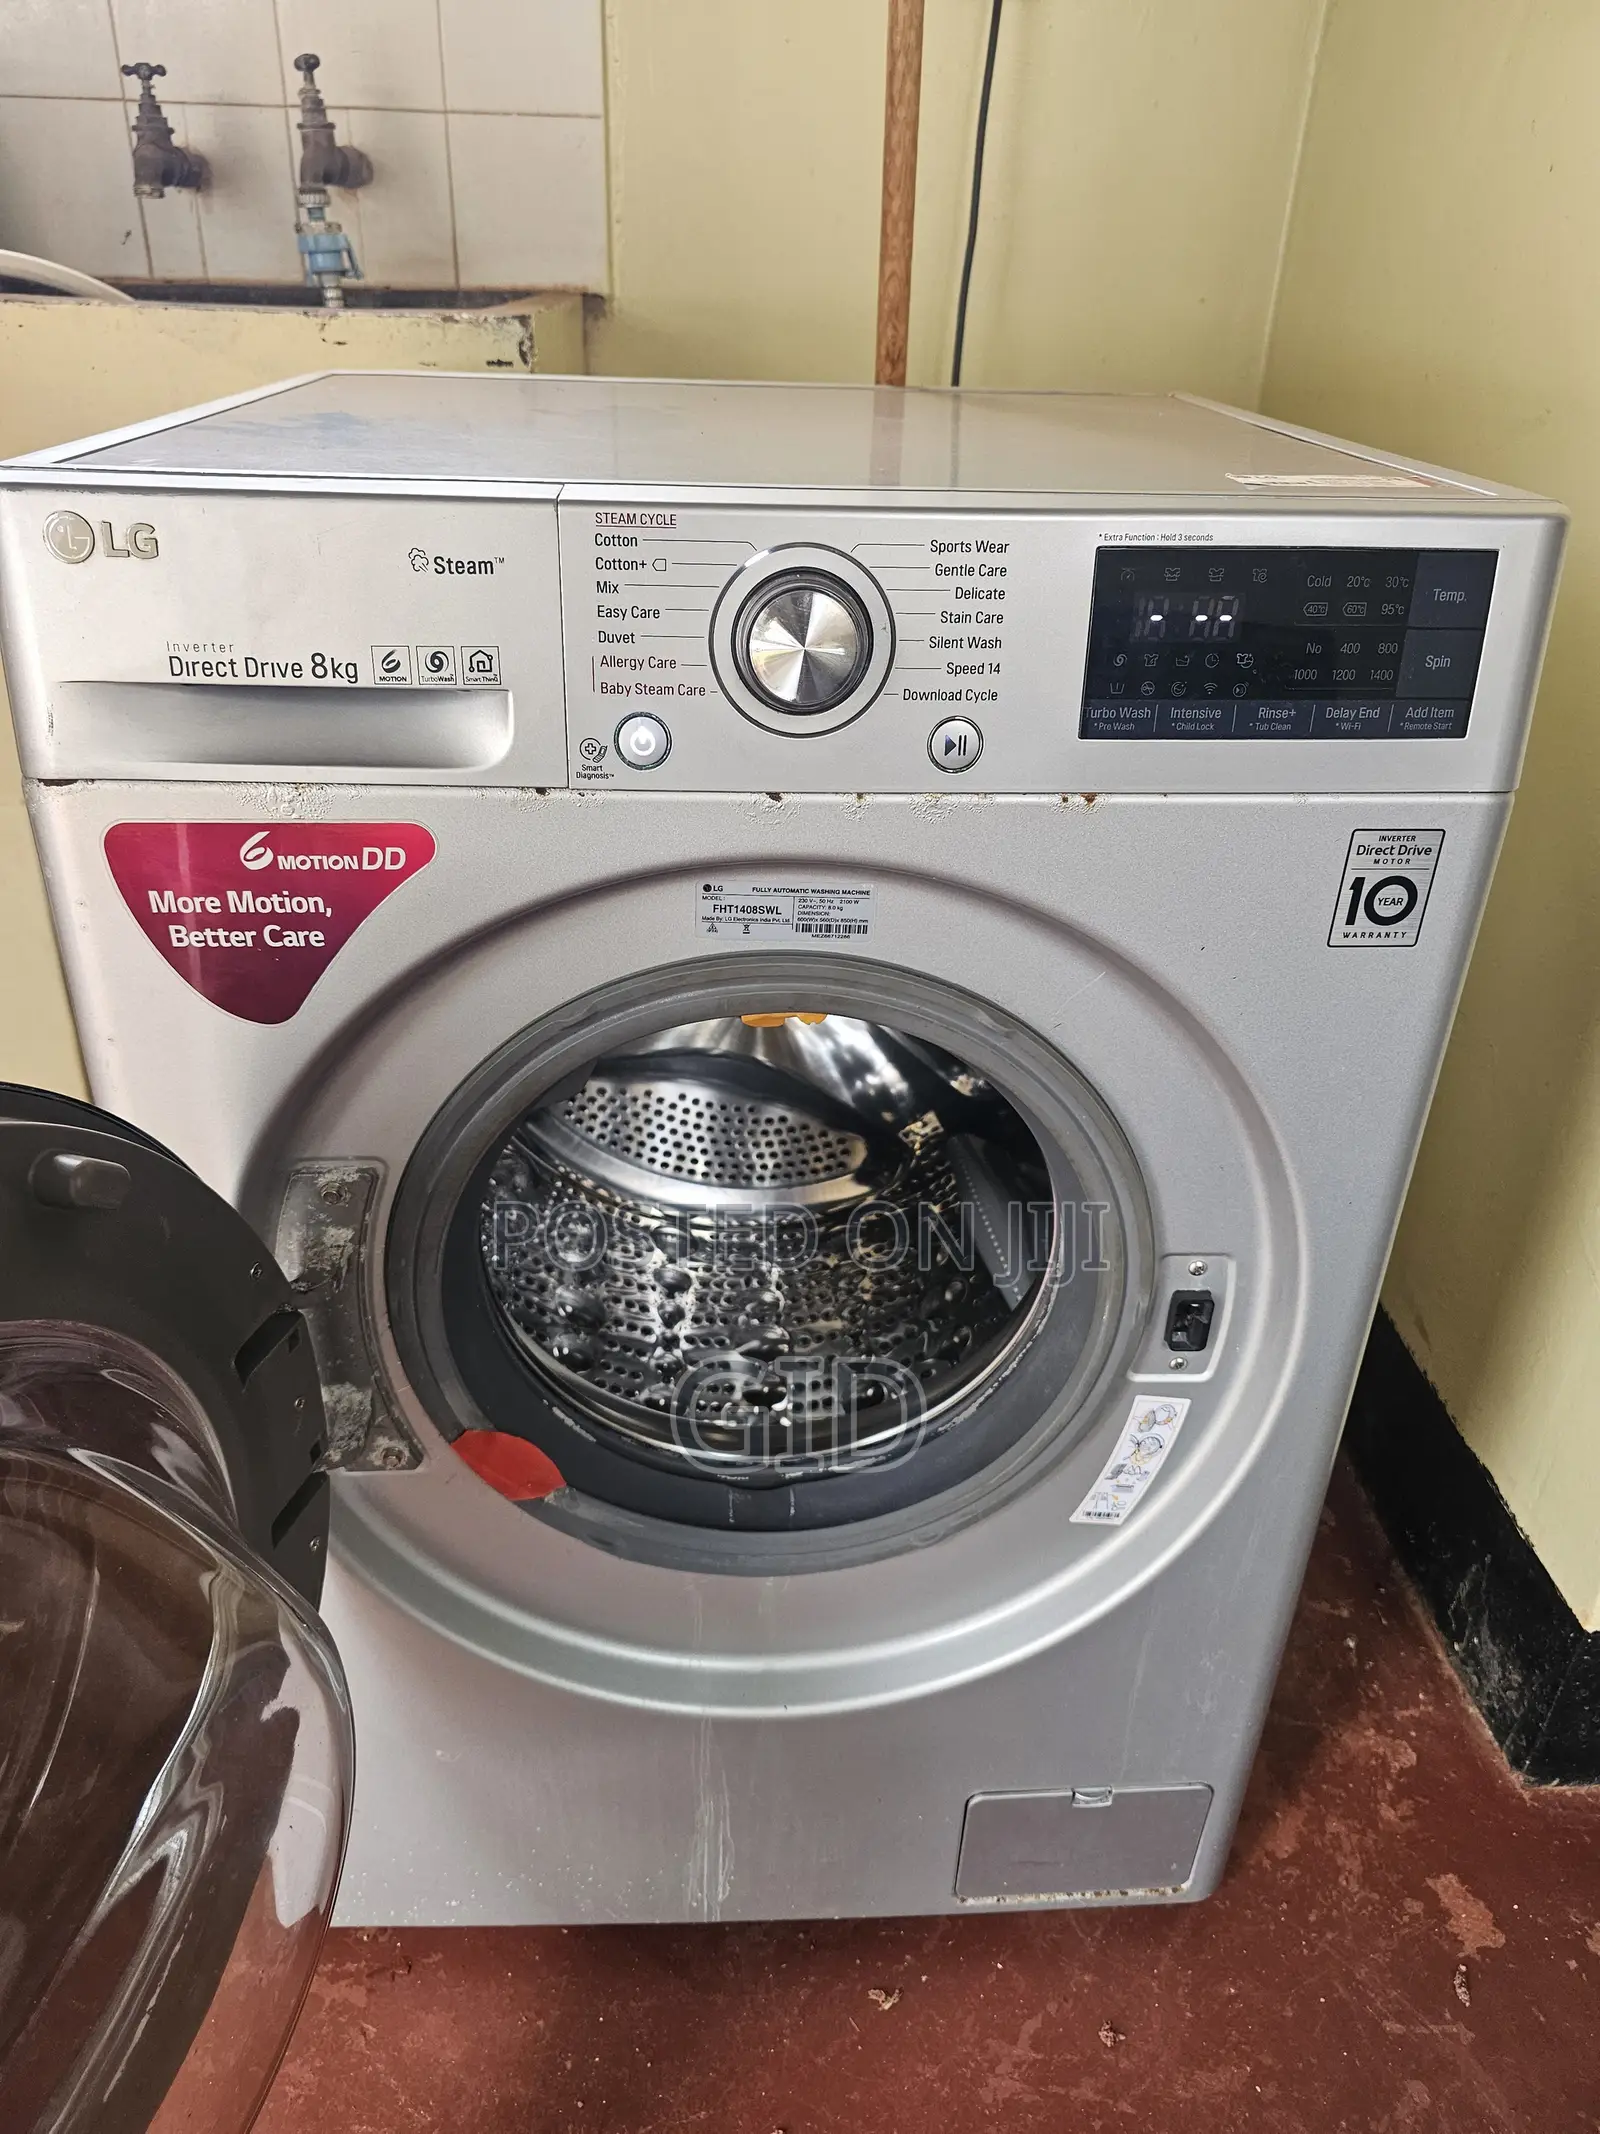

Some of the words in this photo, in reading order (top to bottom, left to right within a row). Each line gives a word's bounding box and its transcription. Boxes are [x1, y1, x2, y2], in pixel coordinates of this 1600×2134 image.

[596, 512, 637, 525] STEAM
[640, 513, 677, 526] CYCLE
[101, 520, 159, 559] LG
[595, 533, 638, 547] Cotton
[930, 540, 972, 555] Sports
[976, 540, 1010, 553] Wear
[596, 557, 647, 571] Cotton+
[935, 564, 975, 577] Gentle
[979, 565, 1007, 577] Care
[597, 581, 619, 594] Mix
[1307, 575, 1332, 588] Cold
[955, 587, 1006, 600] Delicate
[1433, 589, 1467, 603] Temp.
[597, 605, 627, 621] Easy
[631, 606, 660, 619] Care
[941, 611, 972, 624] Stain
[976, 611, 1004, 624] Care
[598, 631, 635, 644] Duvet
[929, 636, 964, 649] Silent
[968, 636, 1002, 649] Wash
[166, 641, 235, 653] Inverter
[1306, 643, 1322, 654] No
[1340, 643, 1361, 654] 400
[1378, 643, 1398, 654] 800
[169, 655, 238, 679] Direct
[245, 656, 303, 679] Drive
[311, 653, 359, 684] 8kg
[600, 656, 644, 670] Allergy
[648, 656, 677, 668] Care
[947, 662, 984, 677] Speed
[989, 663, 1001, 675] 14
[1425, 656, 1451, 670] Spin
[1294, 669, 1318, 680] 1000
[1332, 669, 1356, 680] 1200
[1370, 669, 1394, 680] 1400
[601, 682, 631, 697] Baby
[635, 683, 674, 696] Steam
[678, 684, 706, 696] Care
[903, 689, 962, 701] Download
[966, 689, 998, 703] Cycle
[1120, 707, 1151, 719] Wash
[1171, 707, 1222, 719] Intensive
[1259, 707, 1297, 719] Rinse+
[1326, 707, 1357, 720] Delay
[1359, 707, 1380, 718] End
[1406, 707, 1428, 718] Add
[1431, 707, 1454, 718] Item
[1099, 723, 1111, 731] Pre
[1113, 722, 1135, 731] Wash
[1176, 722, 1195, 731] Child
[1197, 722, 1214, 731] Lock
[1255, 723, 1269, 731] Tub
[1271, 722, 1292, 731] Clean
[1341, 722, 1361, 731] Wi-Fi
[1404, 722, 1432, 731] Remote
[1434, 722, 1452, 731] Start
[582, 764, 603, 772] Smart
[1356, 844, 1396, 856] Direct
[1398, 844, 1432, 856] Drive
[148, 890, 221, 914] More
[227, 890, 332, 917] Motion,
[1345, 875, 1418, 926] 10
[1378, 898, 1404, 906] YEAR
[713, 904, 782, 915] FHT1408SWL
[169, 925, 256, 948] Better
[264, 925, 325, 948] Care
